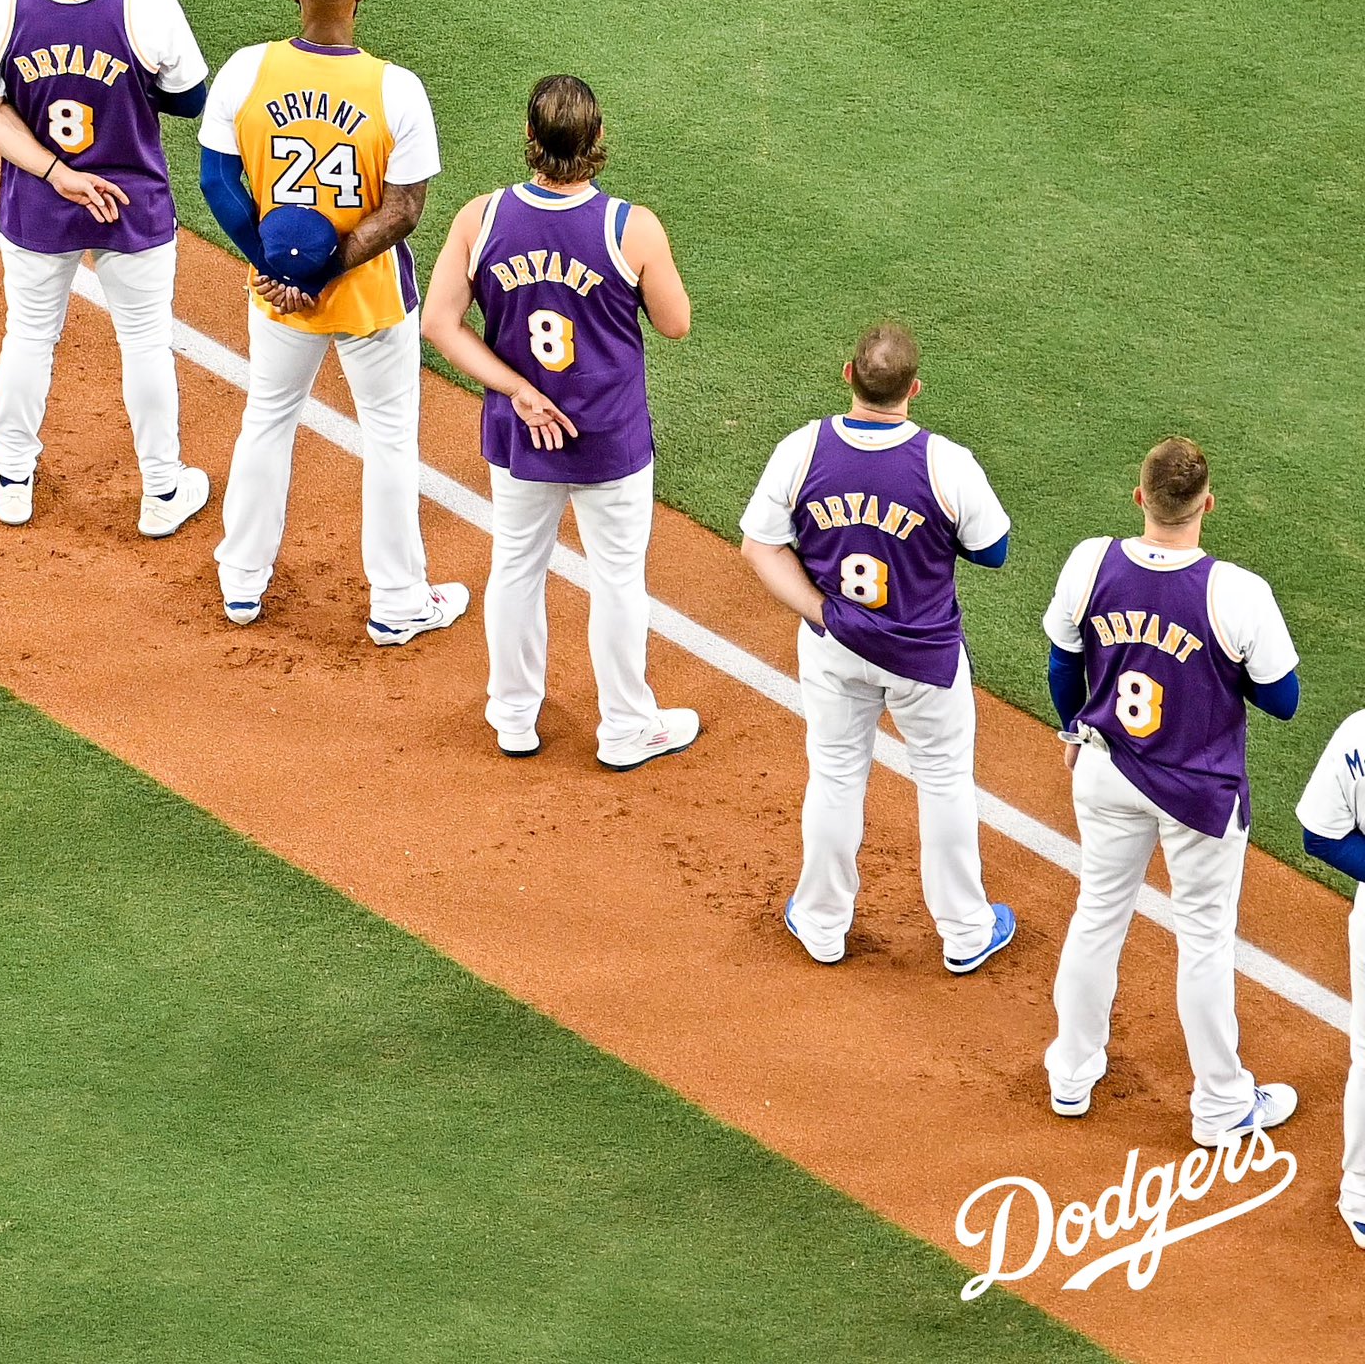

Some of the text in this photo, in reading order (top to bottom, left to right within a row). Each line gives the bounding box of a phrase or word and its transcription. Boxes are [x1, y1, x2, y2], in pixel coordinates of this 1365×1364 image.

[14, 44, 129, 86] BRYANT
[48, 100, 94, 152] 8
[266, 91, 368, 136] BRYANT
[271, 136, 363, 208] 24
[490, 251, 605, 296] BRYANT
[528, 309, 574, 372] 8
[806, 492, 925, 540] BRYANT
[840, 553, 888, 609] 8
[1091, 611, 1203, 663] BRYANT
[1116, 670, 1163, 737] 8
